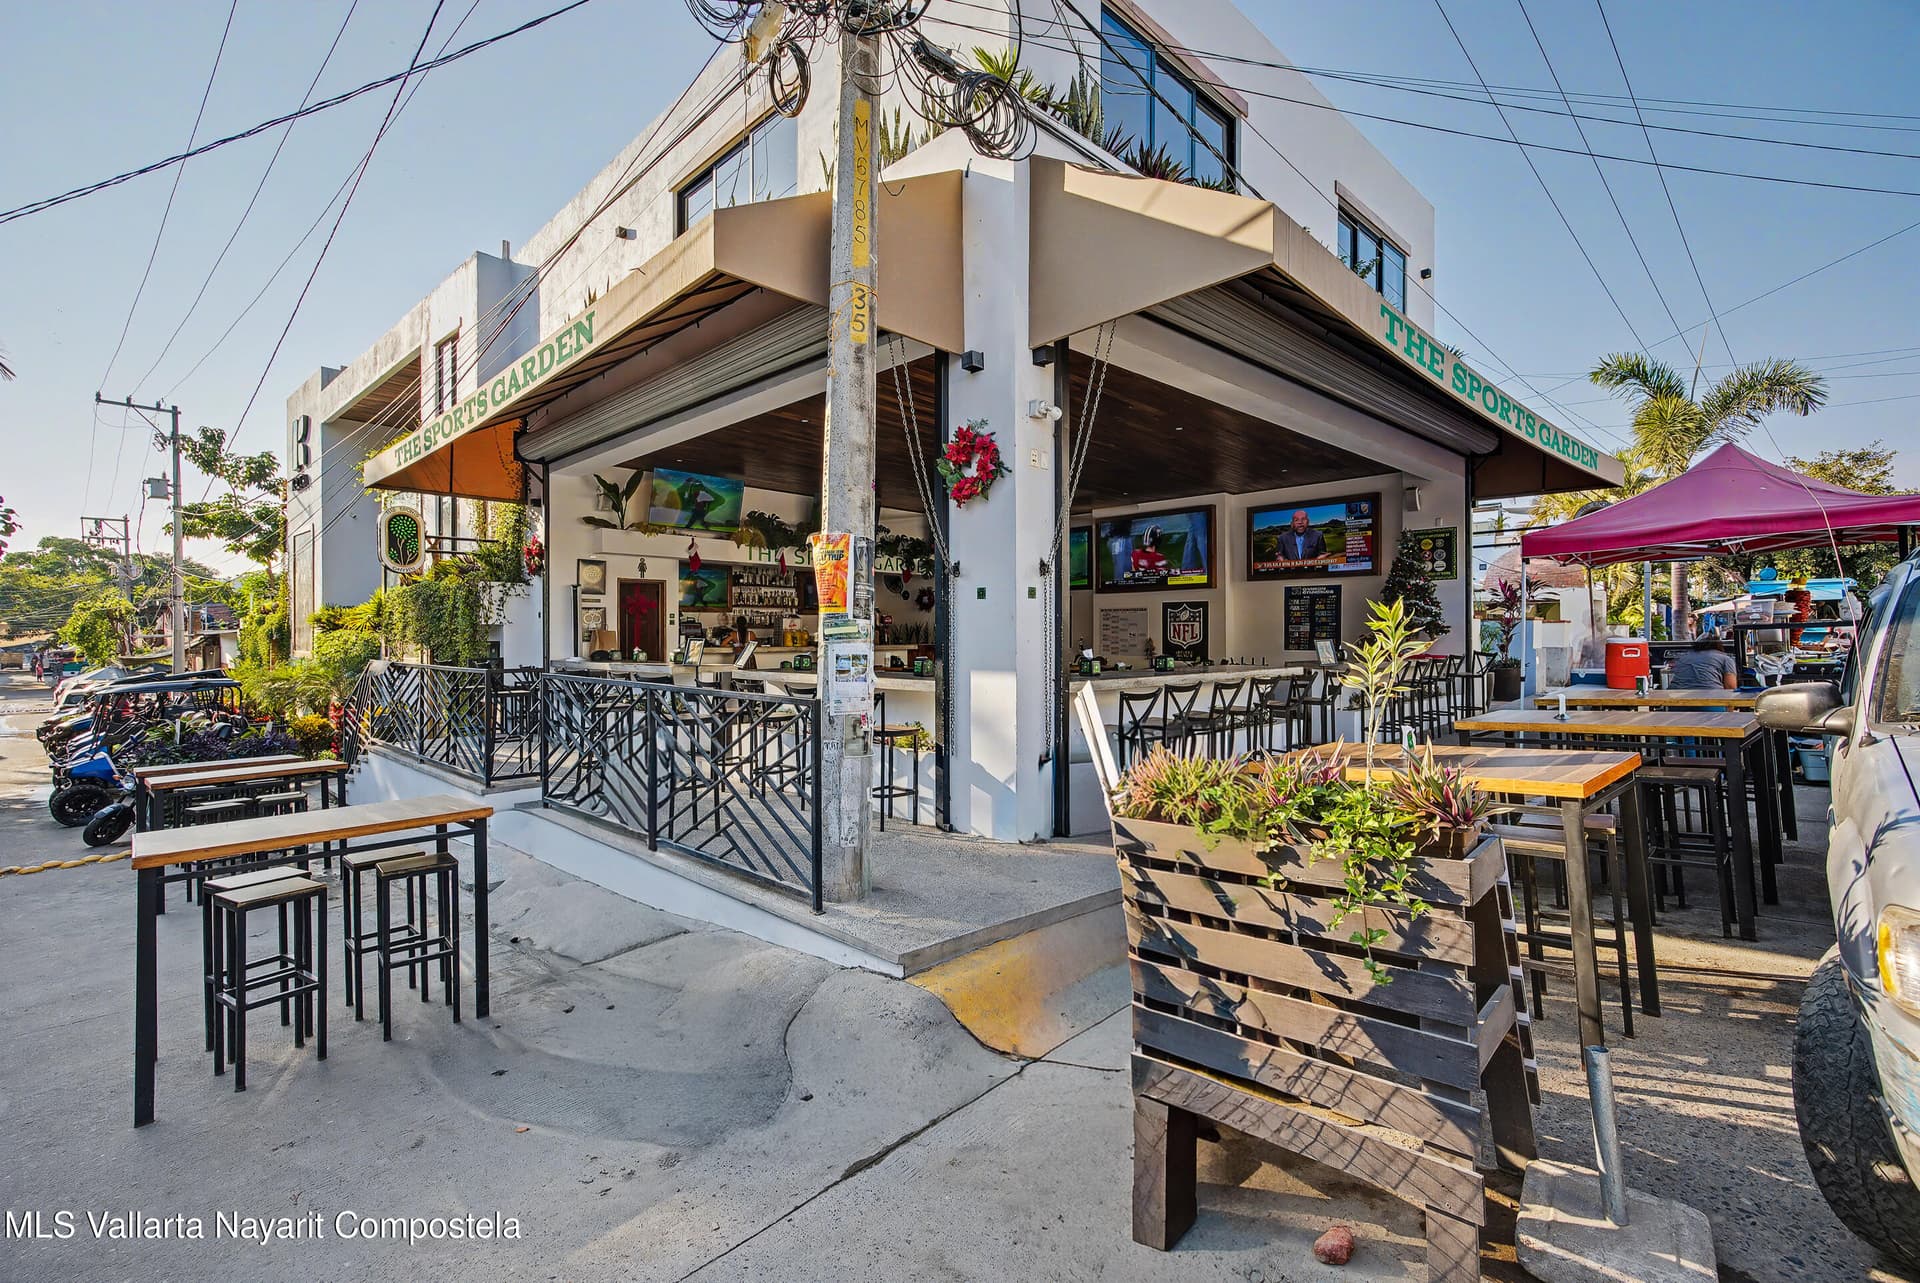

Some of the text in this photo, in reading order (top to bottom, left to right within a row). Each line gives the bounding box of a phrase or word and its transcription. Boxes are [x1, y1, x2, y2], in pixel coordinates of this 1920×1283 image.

[851, 287, 866, 332] 35
[394, 311, 596, 467] THE SPORTS GARDEN
[1380, 304, 1599, 471] THE SPORTS GARDEN
[1172, 623, 1198, 641] NFL
